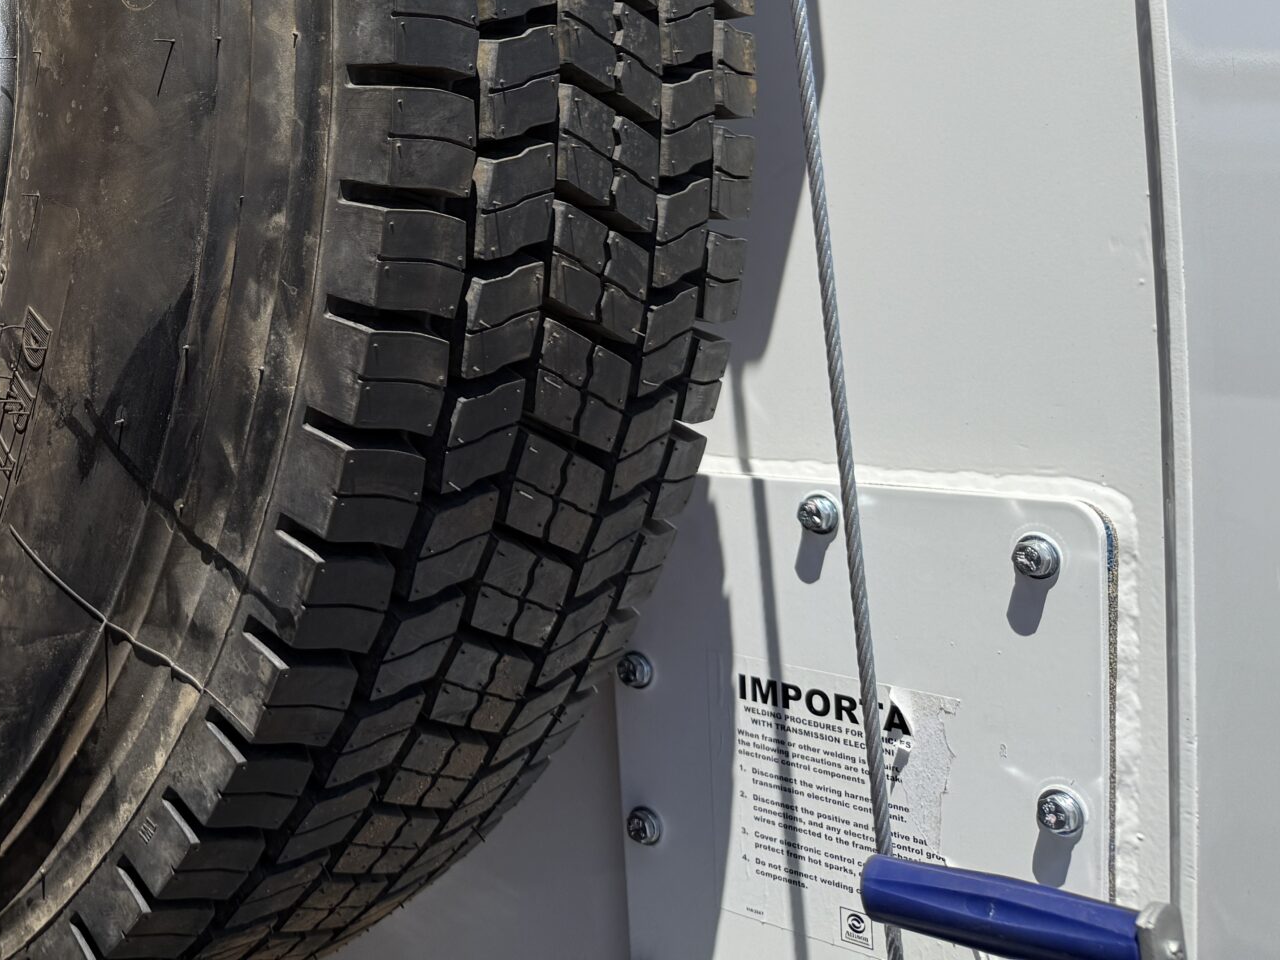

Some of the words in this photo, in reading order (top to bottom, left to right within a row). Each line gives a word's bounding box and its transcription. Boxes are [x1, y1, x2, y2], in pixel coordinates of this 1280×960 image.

[738, 674, 911, 736] IMPORA
[744, 705, 782, 720] WELDING
[784, 715, 842, 734] PROCEDURES
[846, 728, 863, 738] FOR
[737, 728, 759, 740] When
[761, 734, 786, 745] frame
[798, 744, 820, 753] other
[823, 750, 856, 764] welding
[859, 757, 866, 765] is
[751, 718, 773, 728] WITH
[775, 723, 840, 744] TRANSMISSION
[738, 748, 779, 763] electronic
[781, 759, 811, 771] control
[813, 767, 866, 784] components
[753, 742, 789, 758] following
[791, 752, 842, 768] precautions
[844, 764, 859, 773] are
[739, 764, 747, 772] 1.
[752, 767, 797, 784] Disconnect
[799, 780, 813, 789] the
[816, 784, 842, 797] wiring
[752, 778, 805, 797] transmission
[807, 792, 850, 809] electronic
[852, 804, 873, 814] cont
[739, 790, 747, 799] 2.
[752, 794, 799, 812] Disconnect
[801, 806, 815, 816] the
[817, 811, 851, 825] positive
[853, 821, 869, 830] and
[740, 826, 749, 835] 3.
[754, 831, 777, 843] Cover
[779, 839, 822, 856] electronic
[824, 851, 855, 865] control
[753, 805, 806, 825] connections,
[808, 820, 824, 829] and
[826, 825, 841, 835] any
[843, 829, 875, 843] electro
[891, 842, 924, 855] control
[753, 815, 776, 826] wires
[778, 821, 822, 838] connected
[824, 833, 833, 842] to
[836, 837, 850, 846] the
[741, 854, 750, 862] 4.
[755, 857, 766, 866] Do
[768, 862, 782, 871] not
[783, 867, 818, 881] connect
[820, 877, 854, 893] welding
[754, 842, 785, 855] protect
[786, 850, 806, 861] from
[808, 856, 822, 866] hot
[824, 861, 856, 877] sparks,
[755, 869, 809, 889] components.
